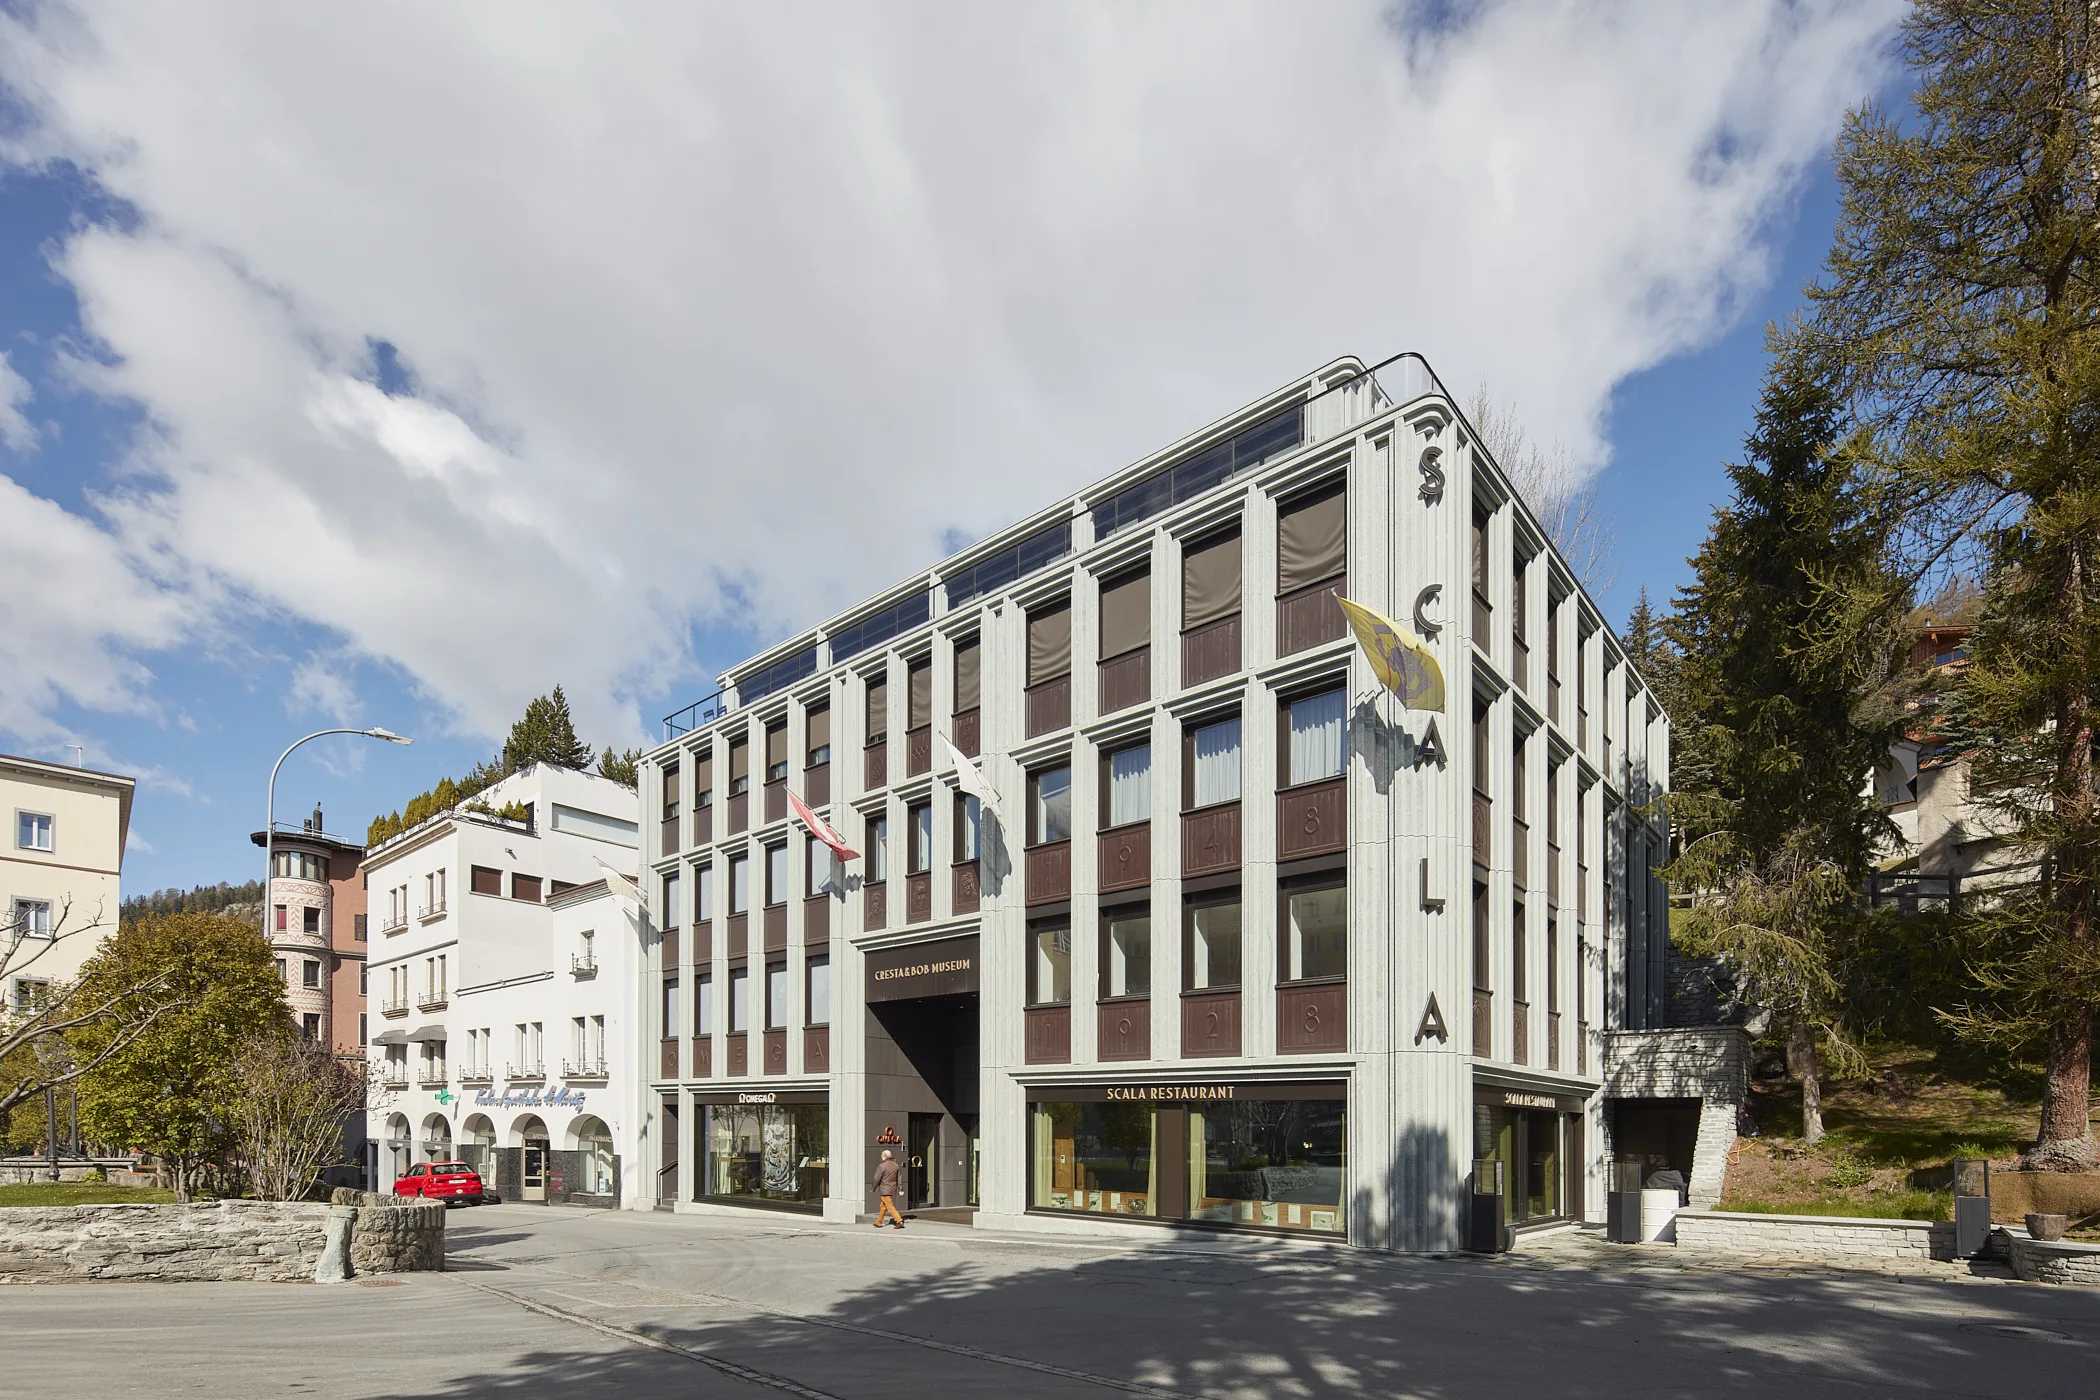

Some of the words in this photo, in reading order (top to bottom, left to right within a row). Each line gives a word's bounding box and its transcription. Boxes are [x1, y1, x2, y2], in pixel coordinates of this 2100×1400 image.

[874, 963, 930, 981] CRESTA&BOB
[931, 958, 970, 974] MUSEUM
[1106, 1087, 1146, 1100] SCALA
[1150, 1086, 1235, 1100] RESTAURANT
